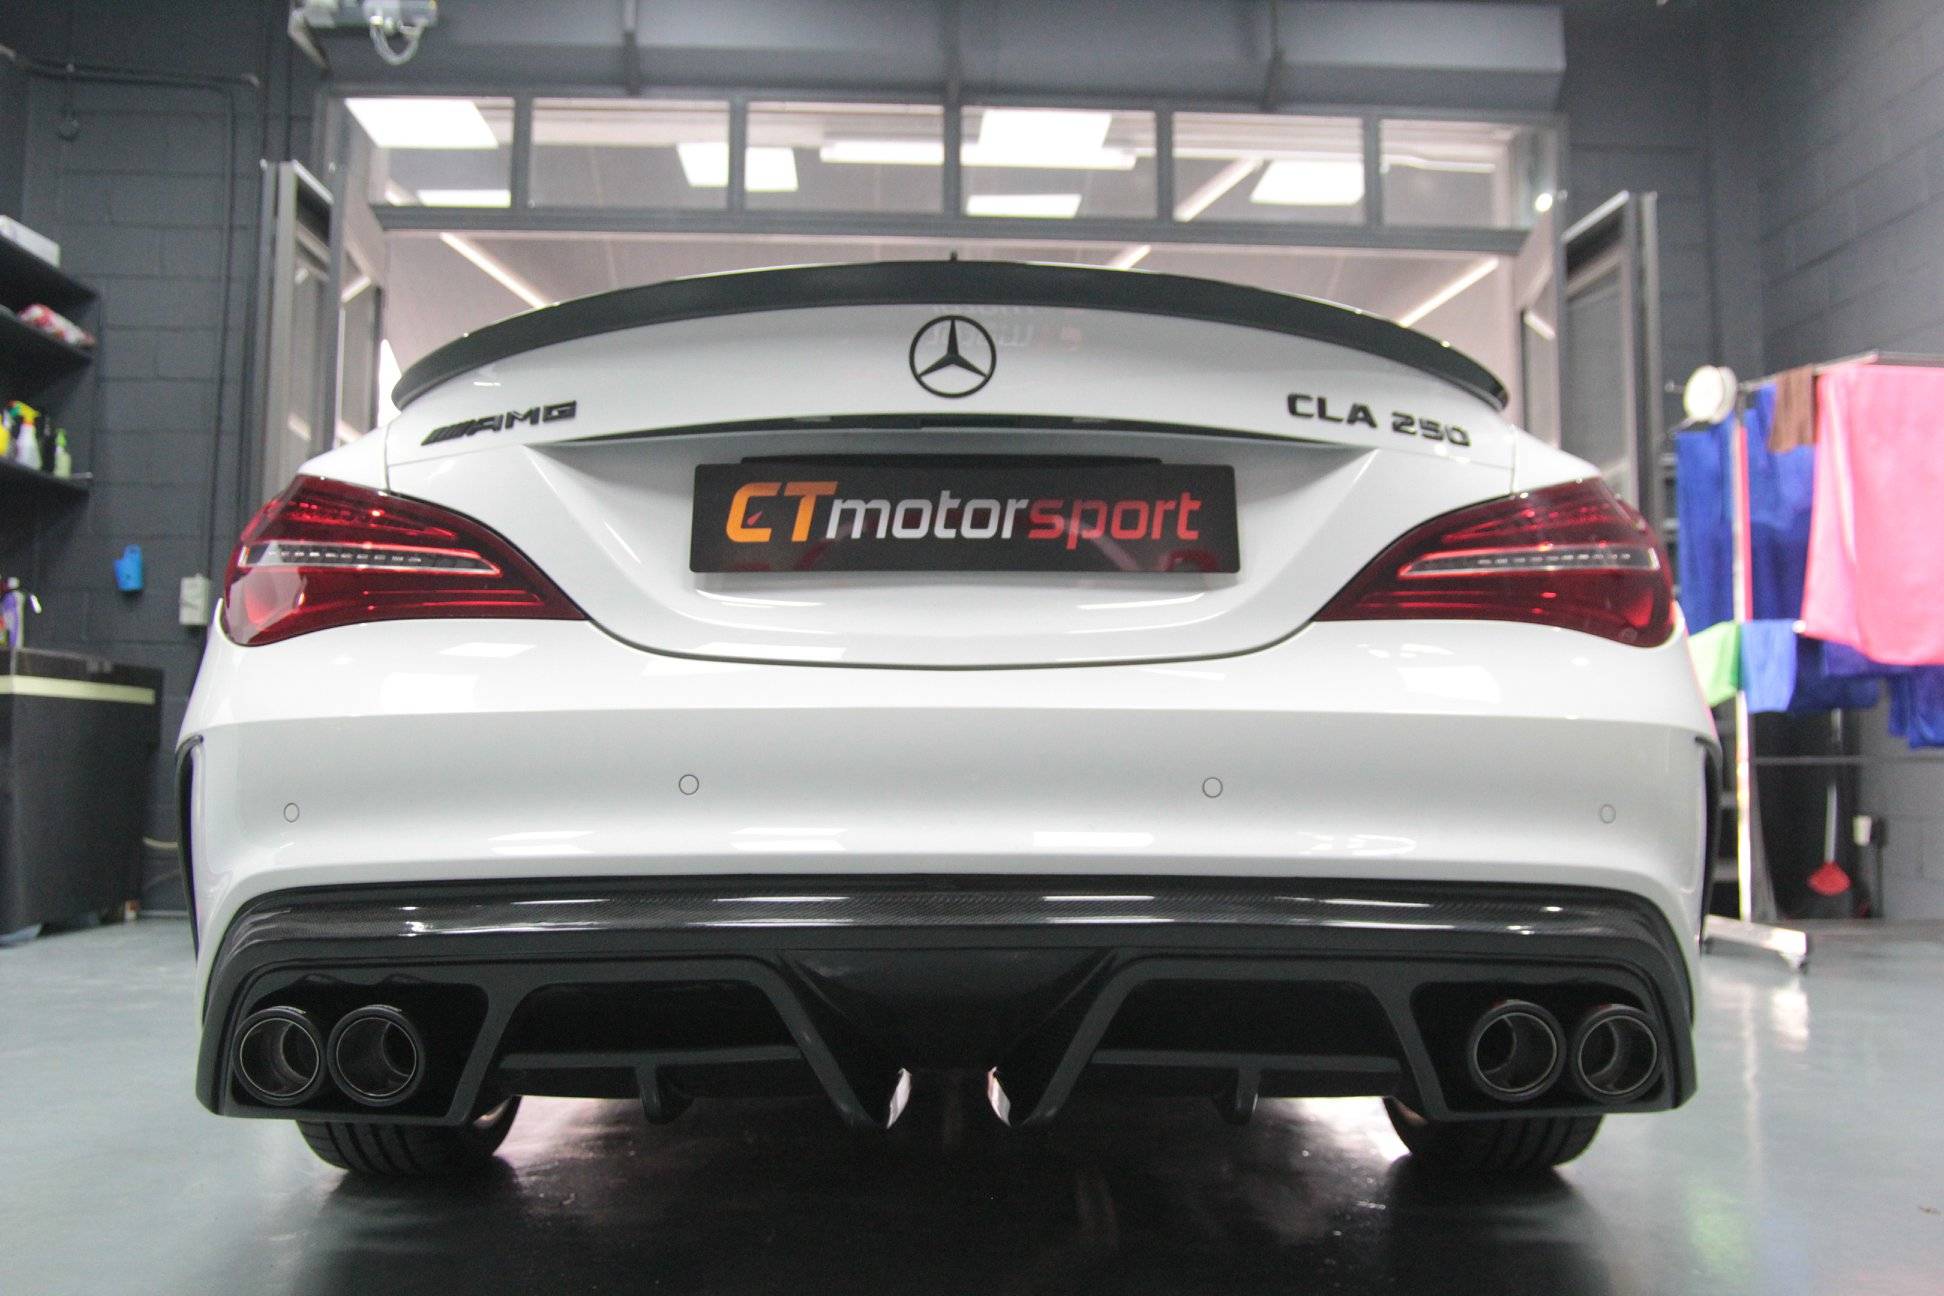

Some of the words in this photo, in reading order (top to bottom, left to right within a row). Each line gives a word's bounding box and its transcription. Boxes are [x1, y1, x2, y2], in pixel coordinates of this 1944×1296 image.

[451, 400, 577, 438] AMG
[1286, 392, 1378, 429] CLA
[1391, 410, 1471, 447] 250
